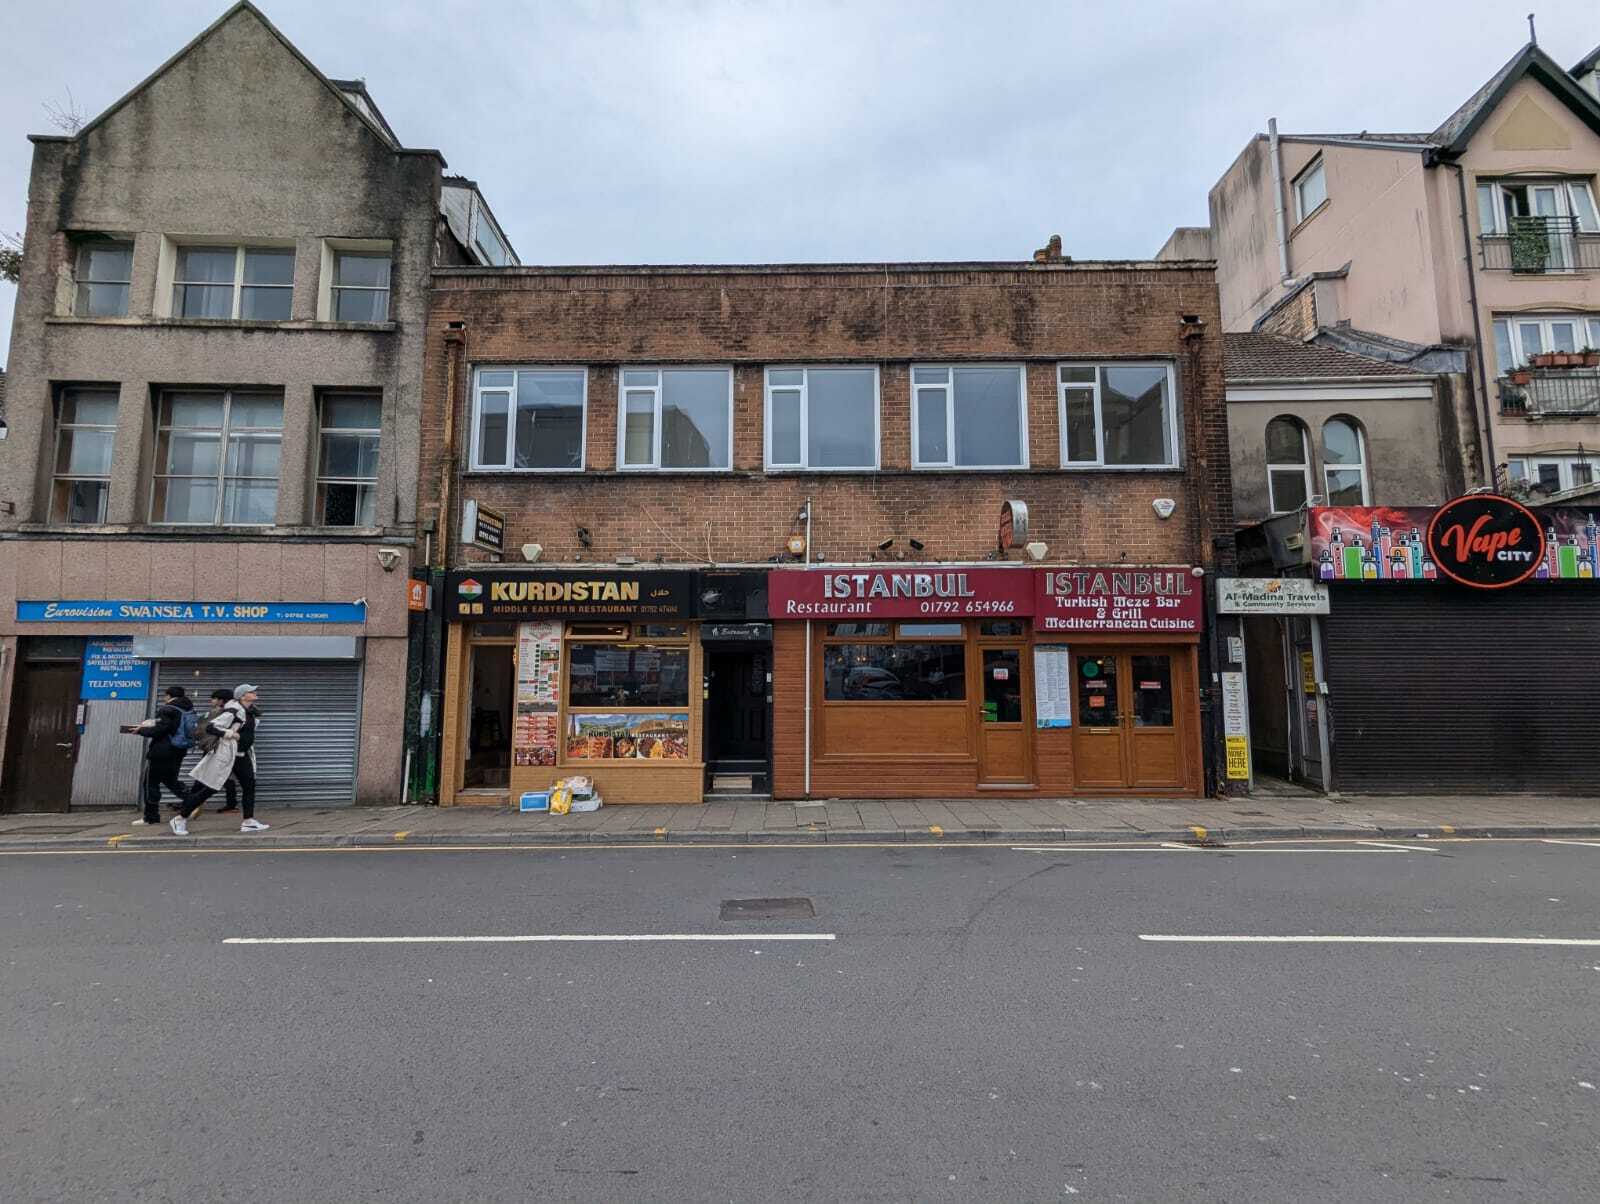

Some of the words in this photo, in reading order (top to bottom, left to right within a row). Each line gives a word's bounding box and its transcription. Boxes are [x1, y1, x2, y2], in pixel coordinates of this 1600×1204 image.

[1441, 515, 1521, 562] Vape
[1497, 551, 1532, 561] CITY
[824, 574, 975, 598] ISTANBUL
[1046, 573, 1192, 595] ISTANBUL
[491, 582, 639, 601] KURDISTAN
[1225, 592, 1283, 601] Al-Madina
[1287, 592, 1326, 601] Travels
[787, 600, 872, 613] Restaurant
[921, 601, 959, 613] 01792
[966, 601, 1014, 613] 654966
[1055, 596, 1107, 607] Turkish
[1113, 596, 1149, 607] Meze
[1156, 596, 1180, 607] Bar
[45, 603, 112, 617] Eurovision
[120, 605, 193, 617] SWANSEA
[202, 606, 229, 617] T.V.
[233, 606, 268, 617] SHOP
[493, 605, 528, 613] MIDDLE
[532, 605, 575, 613] EASTERN
[579, 605, 637, 613] RESTAURANT
[1097, 608, 1105, 618] &
[1112, 608, 1141, 618] Grill
[1045, 617, 1147, 628] Mediterranean
[1150, 617, 1195, 628] Cuisine
[88, 680, 142, 688] TELEVISIONS
[588, 730, 630, 738] KURDISTAN
[1228, 758, 1246, 768] HERE
